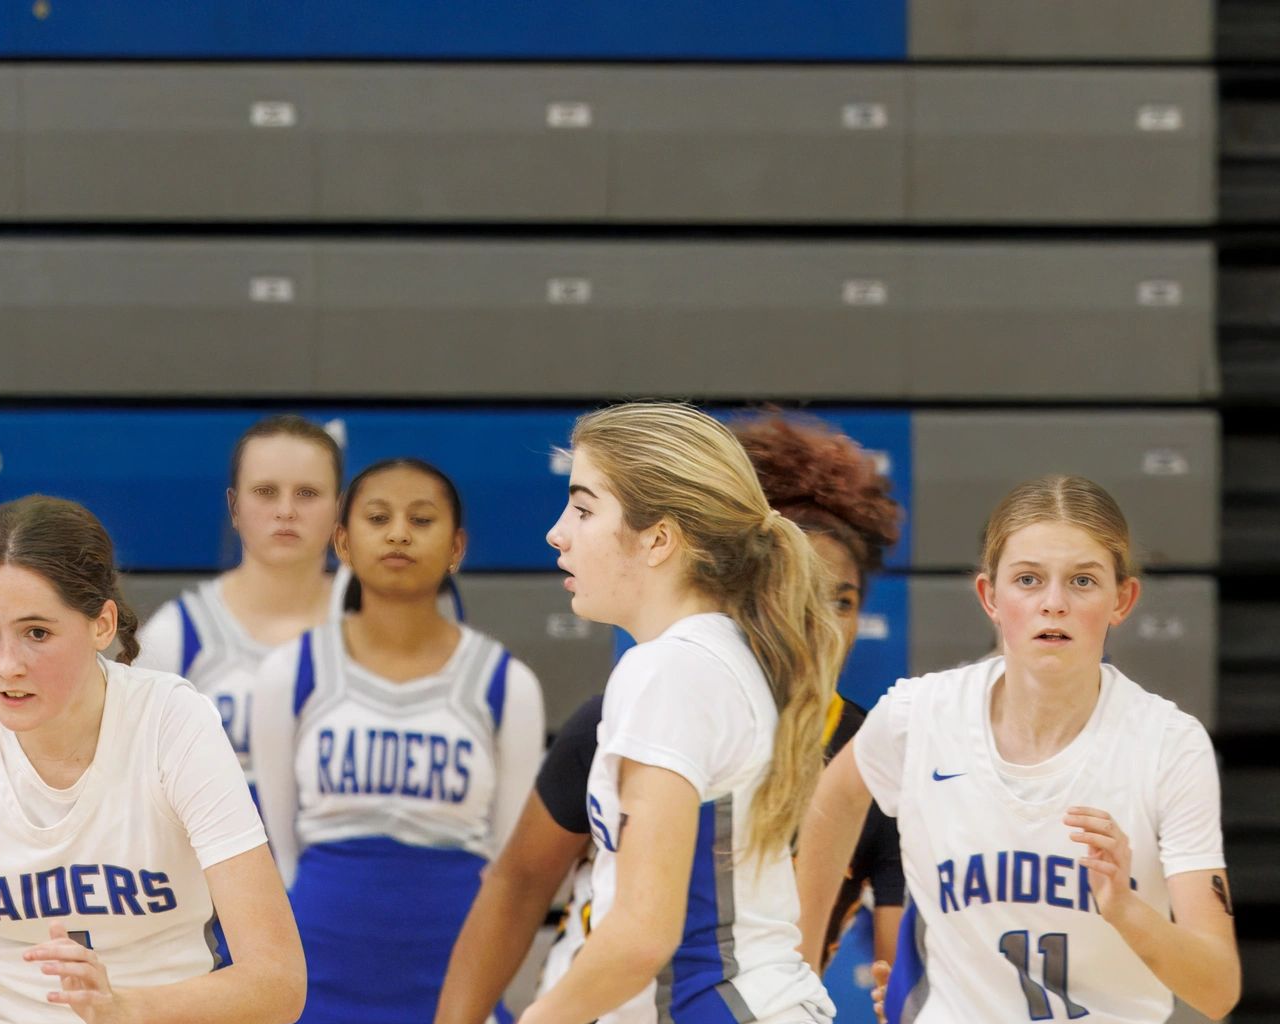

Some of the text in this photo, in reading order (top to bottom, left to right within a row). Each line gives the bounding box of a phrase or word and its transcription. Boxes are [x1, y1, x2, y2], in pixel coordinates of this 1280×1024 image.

[318, 727, 474, 803] RAIDERS
[937, 850, 1138, 915] RAIDE
[998, 929, 1090, 1021] 11
